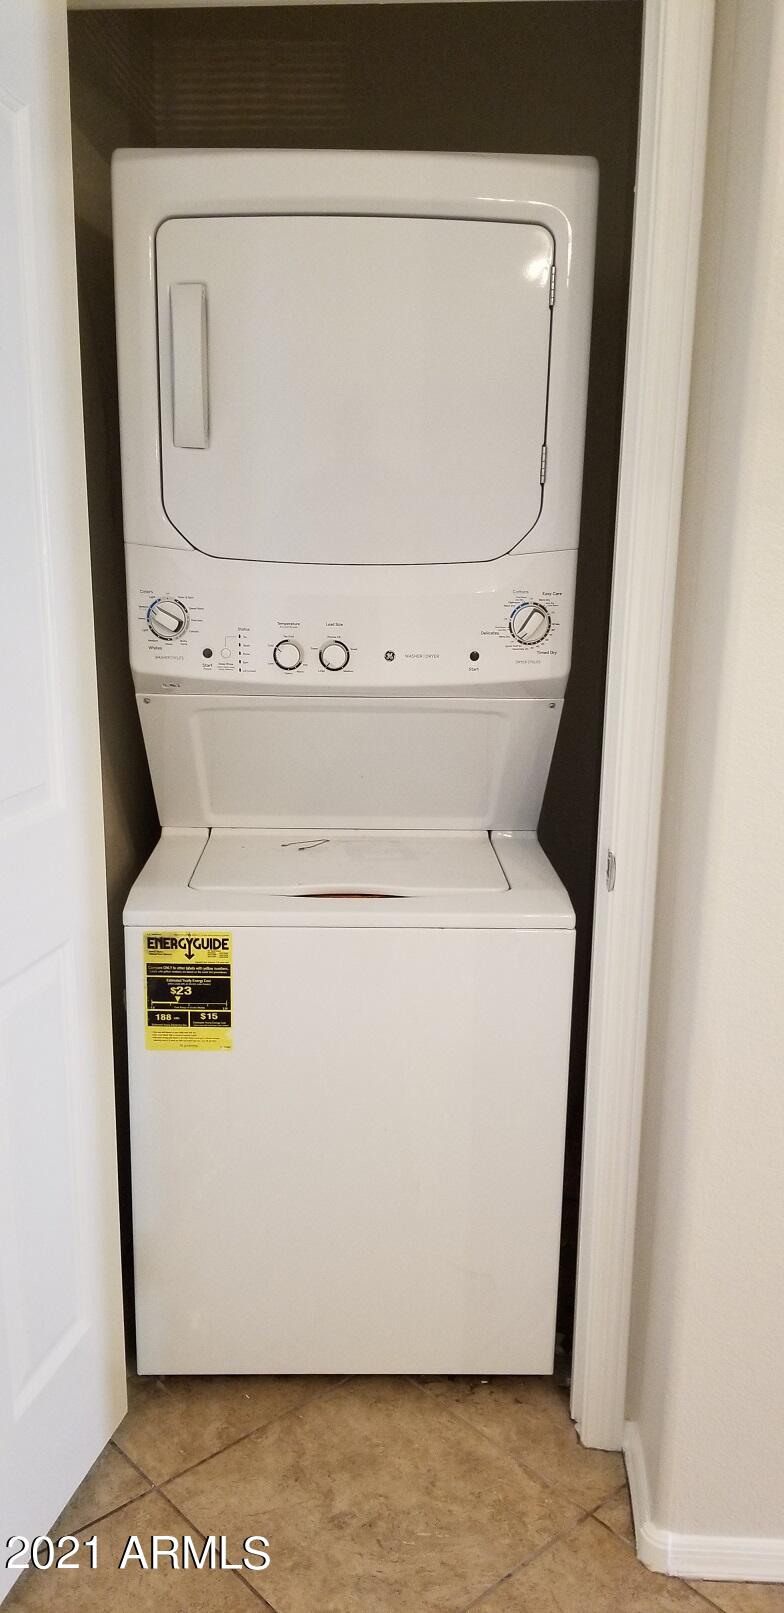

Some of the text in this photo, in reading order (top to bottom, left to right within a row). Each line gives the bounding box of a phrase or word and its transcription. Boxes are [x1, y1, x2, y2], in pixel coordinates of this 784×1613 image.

[147, 936, 230, 953] ENERGYGUIDE
[170, 986, 192, 996] $23
[155, 1013, 172, 1021] 188
[200, 1012, 218, 1020] $15
